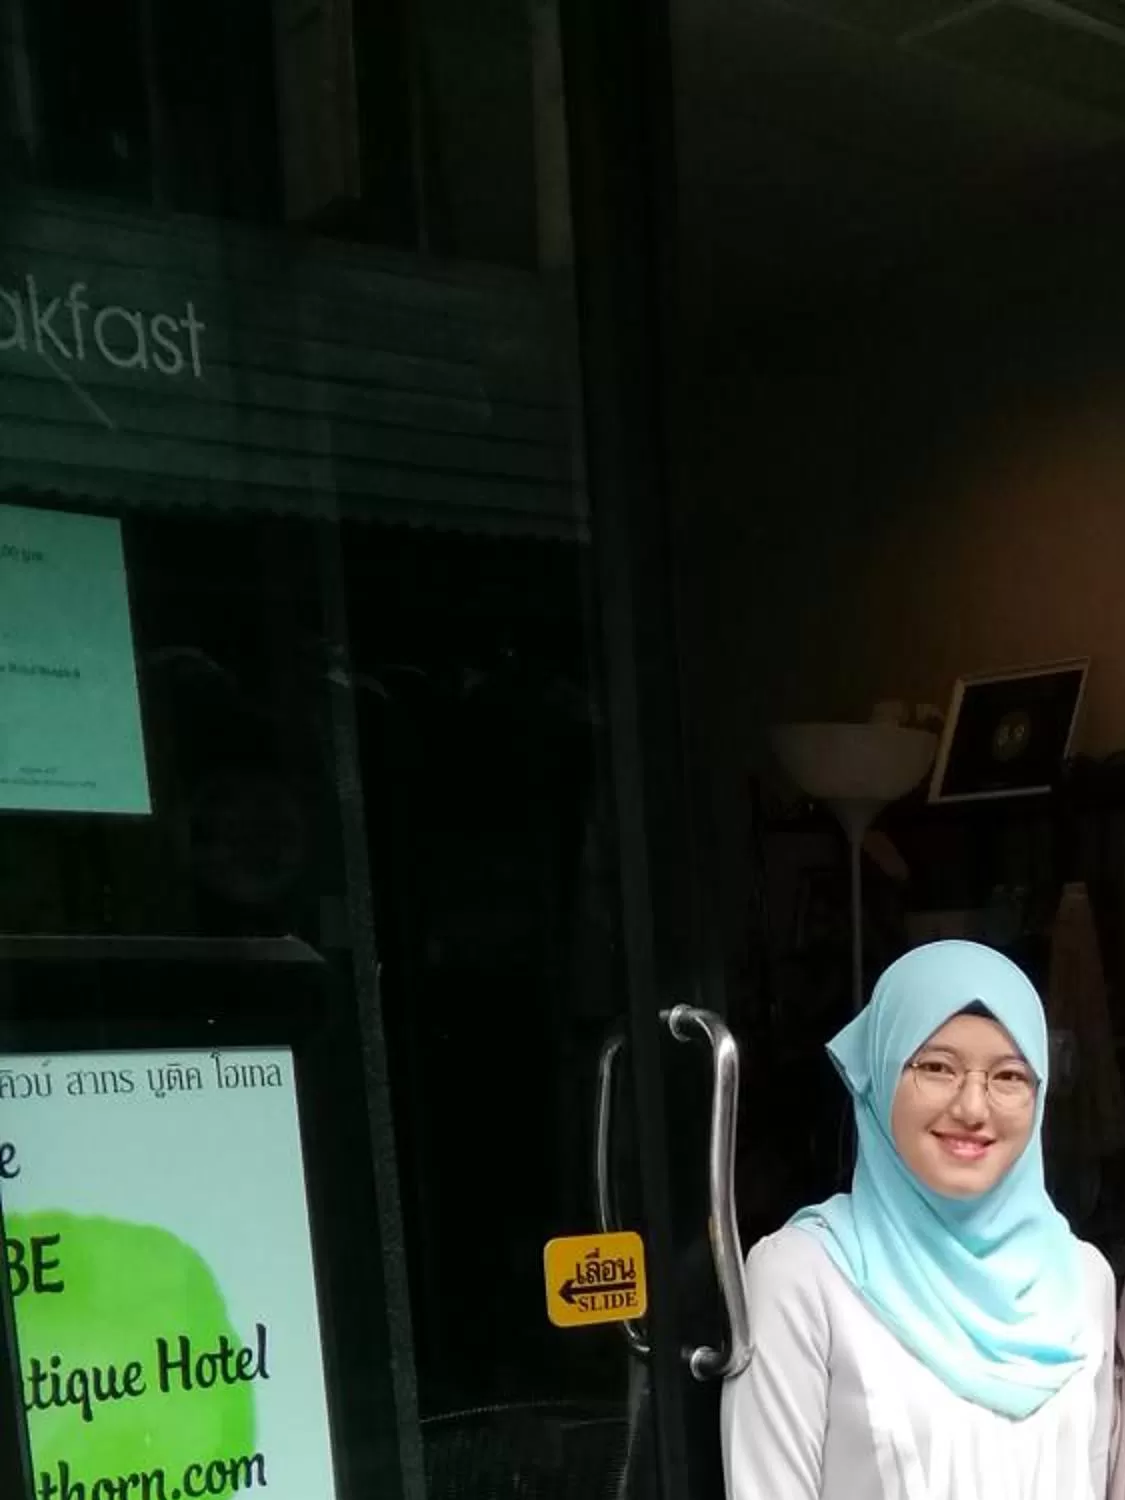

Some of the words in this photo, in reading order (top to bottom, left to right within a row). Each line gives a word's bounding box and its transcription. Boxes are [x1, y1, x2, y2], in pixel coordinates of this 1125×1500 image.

[578, 1291, 639, 1312] SLIDE
[23, 1355, 147, 1422] tique
[156, 1323, 270, 1393] Hotel
